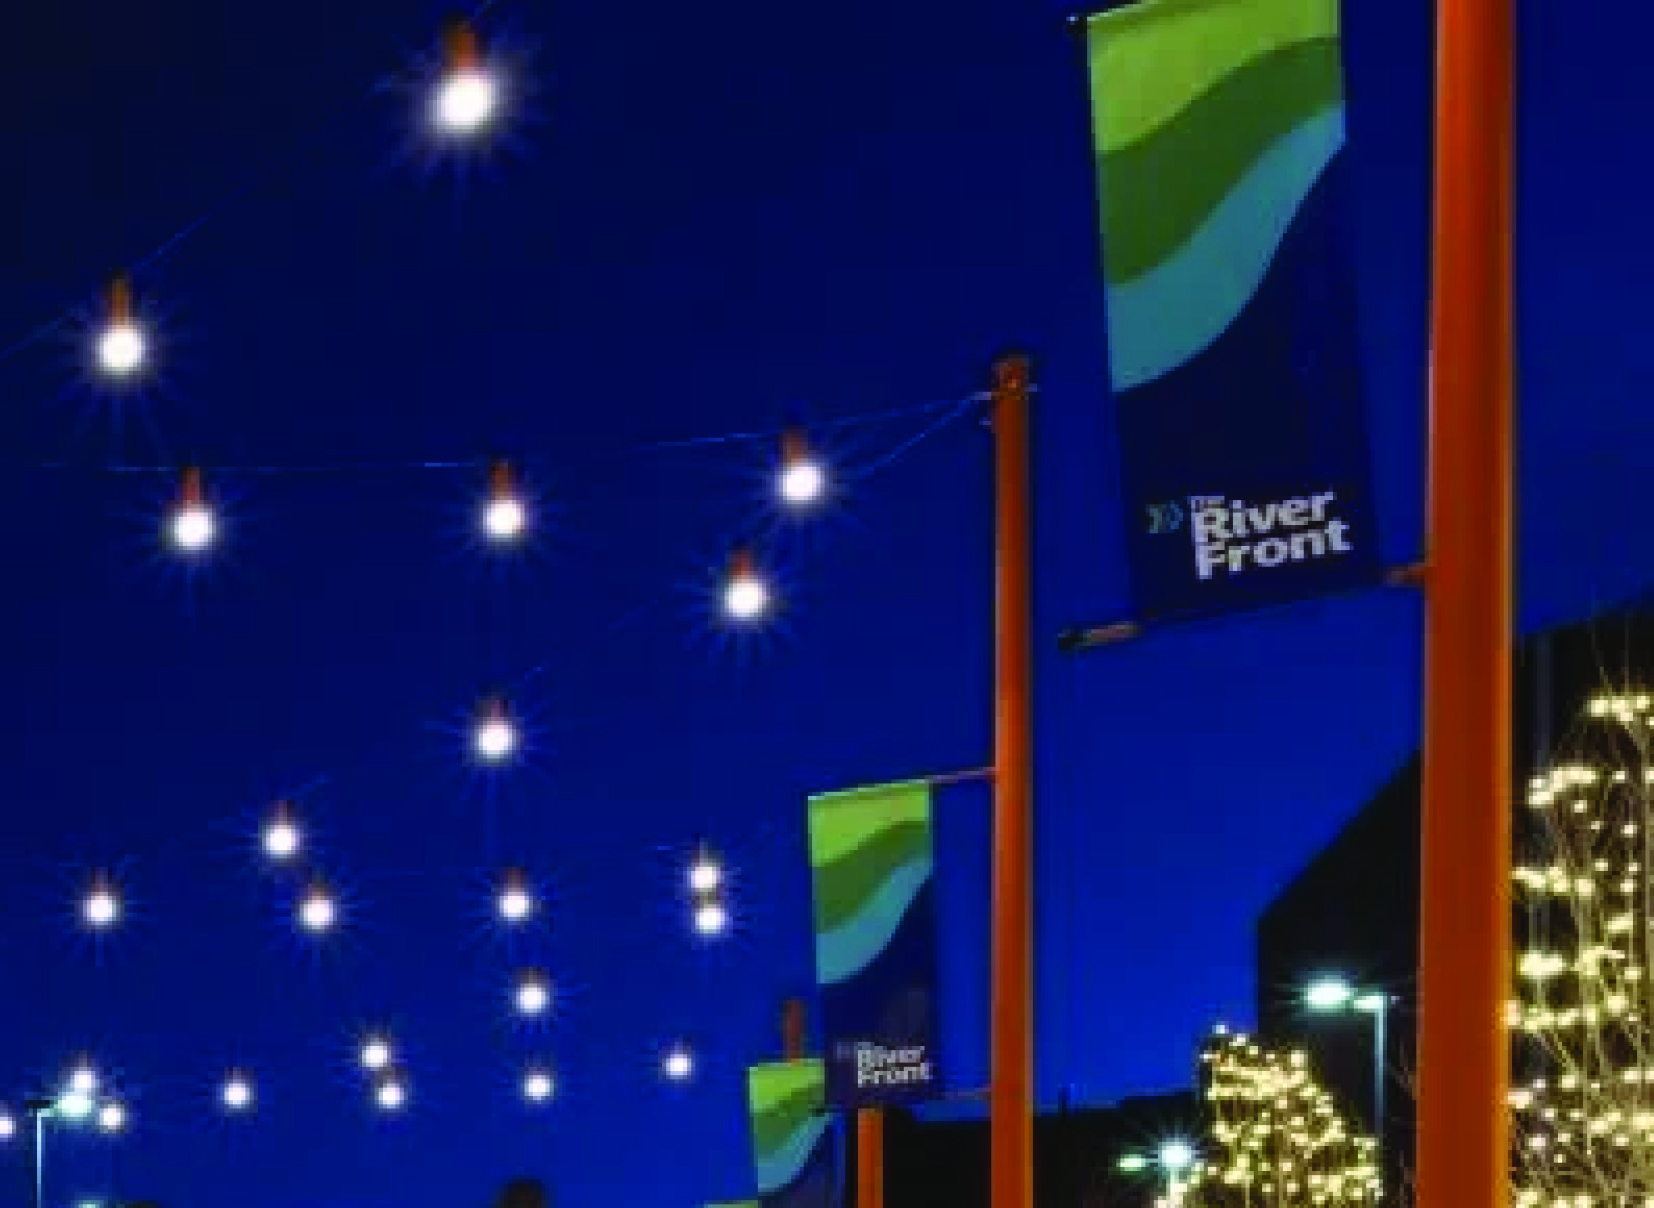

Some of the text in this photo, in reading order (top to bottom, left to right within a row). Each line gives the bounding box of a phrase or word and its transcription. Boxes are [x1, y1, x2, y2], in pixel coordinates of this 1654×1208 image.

[1191, 491, 1337, 545] River
[1194, 520, 1353, 581] Front
[857, 1046, 926, 1070] River
[857, 1061, 934, 1089] Front
